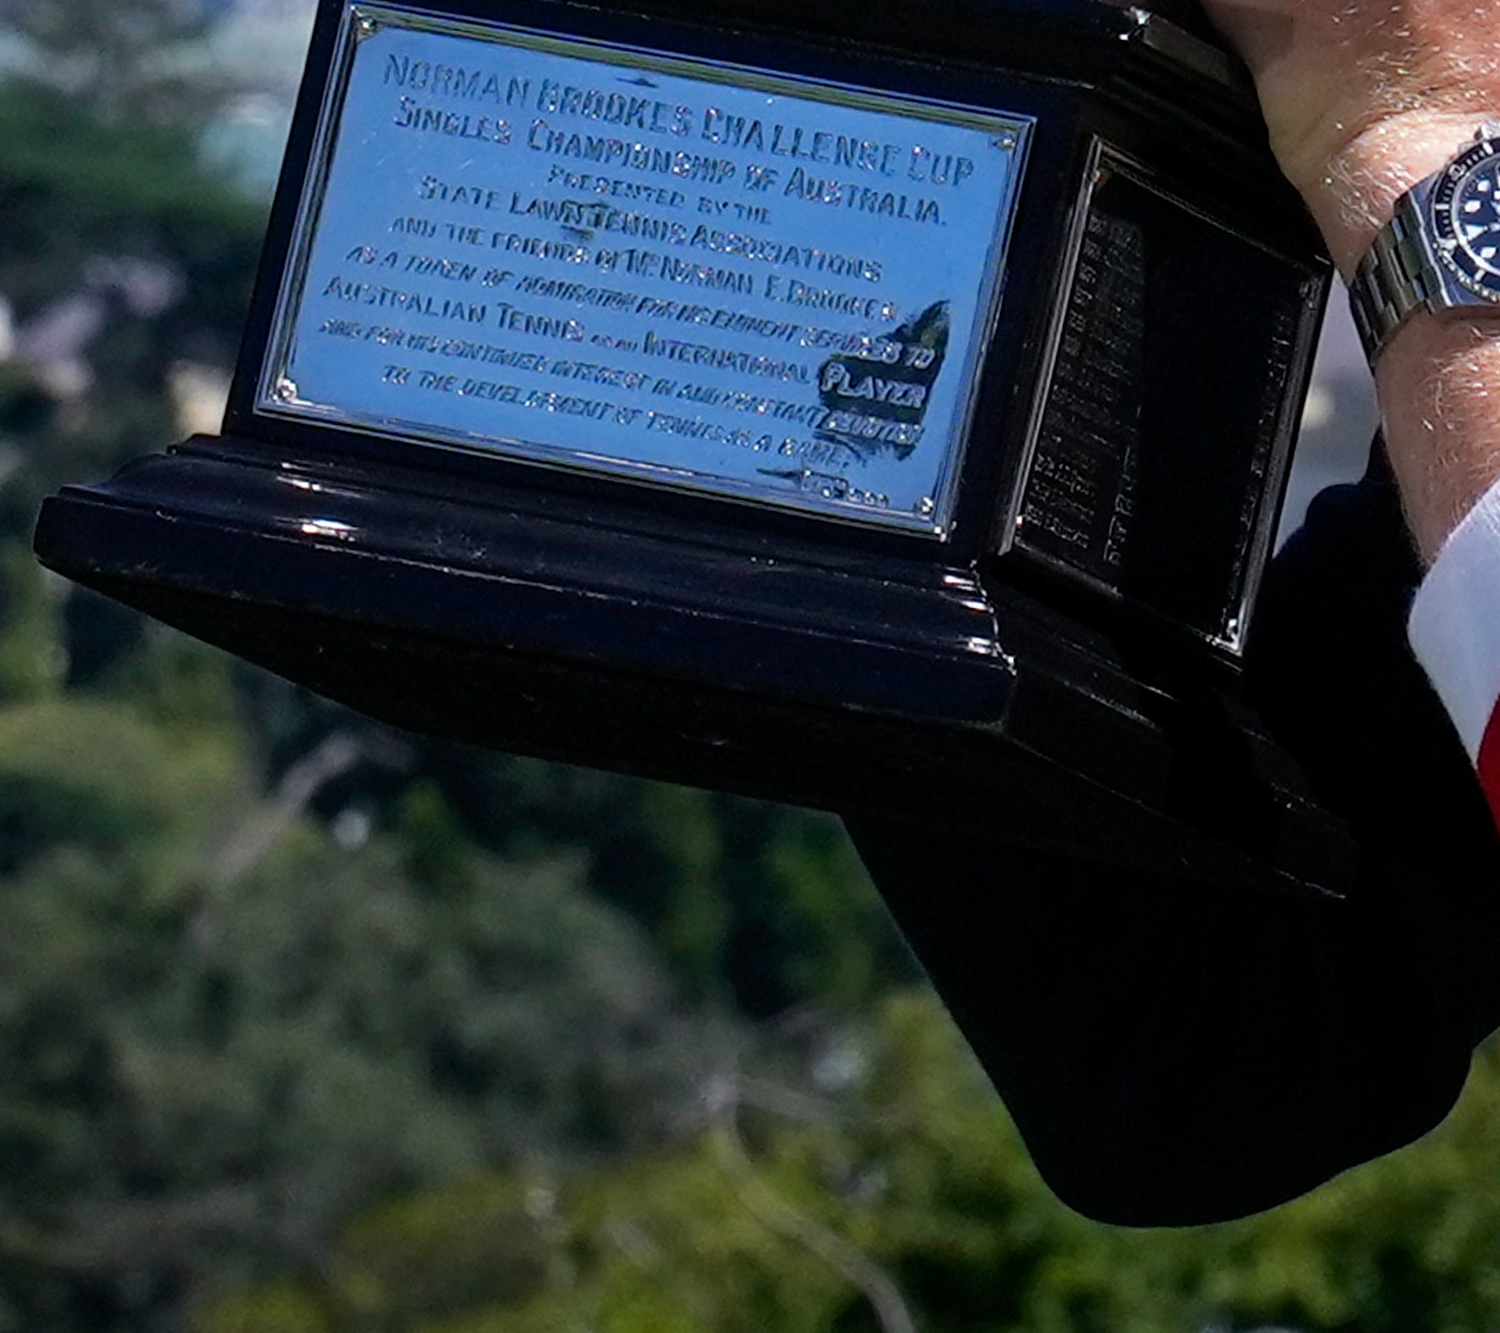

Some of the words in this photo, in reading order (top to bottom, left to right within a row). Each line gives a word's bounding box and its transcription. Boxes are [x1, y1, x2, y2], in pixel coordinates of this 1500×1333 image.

[383, 54, 530, 108] NORMAN
[538, 79, 694, 138] BROOKES
[701, 108, 901, 175] CHALLENGE
[906, 145, 975, 188] CUP
[394, 96, 513, 144] SINGLES
[526, 119, 736, 186] CHAMPIONSHIP
[743, 164, 779, 194] OF
[784, 167, 950, 225] AUSTRALIA.
[418, 176, 499, 210] STATE
[510, 193, 584, 225] LAWN
[585, 206, 686, 245] TENNIS
[690, 225, 883, 282] ASSOCIATIONS
[549, 166, 684, 208] PRESENTED
[698, 198, 726, 215] BY
[733, 204, 772, 223] THE
[346, 245, 376, 265] AS
[380, 251, 397, 268] A
[405, 254, 475, 282] TOKEN
[483, 269, 514, 289] OF
[516, 274, 633, 311] ADMIRATION
[636, 296, 676, 320] FOR
[676, 304, 710, 326] HIS
[711, 310, 799, 342] EMINENT
[799, 326, 901, 364] SERVICES
[903, 345, 935, 370] TO
[390, 214, 435, 238] AND
[444, 224, 485, 246] THE
[491, 232, 588, 265] FRIENDS
[595, 250, 616, 272] OF
[660, 256, 754, 294] NORMAN
[320, 317, 361, 339] AND
[364, 325, 402, 346] FOR
[407, 333, 437, 353] HIS
[439, 338, 548, 373] CONTINUED
[551, 359, 648, 392] INTEREST
[653, 379, 676, 397] IN
[677, 382, 719, 404] AND
[720, 390, 827, 428] CONSTANT
[323, 275, 487, 325] AUSTRALIAN
[494, 303, 586, 342] TENNIS
[642, 331, 813, 385] INTERNATIONAL
[821, 362, 927, 409] PLAYER
[382, 364, 409, 385] TO
[418, 371, 457, 393] THE
[458, 378, 613, 422] DEVELOPMENT
[614, 407, 641, 427] OF
[646, 412, 724, 442] TENNIS
[753, 434, 771, 451] A
